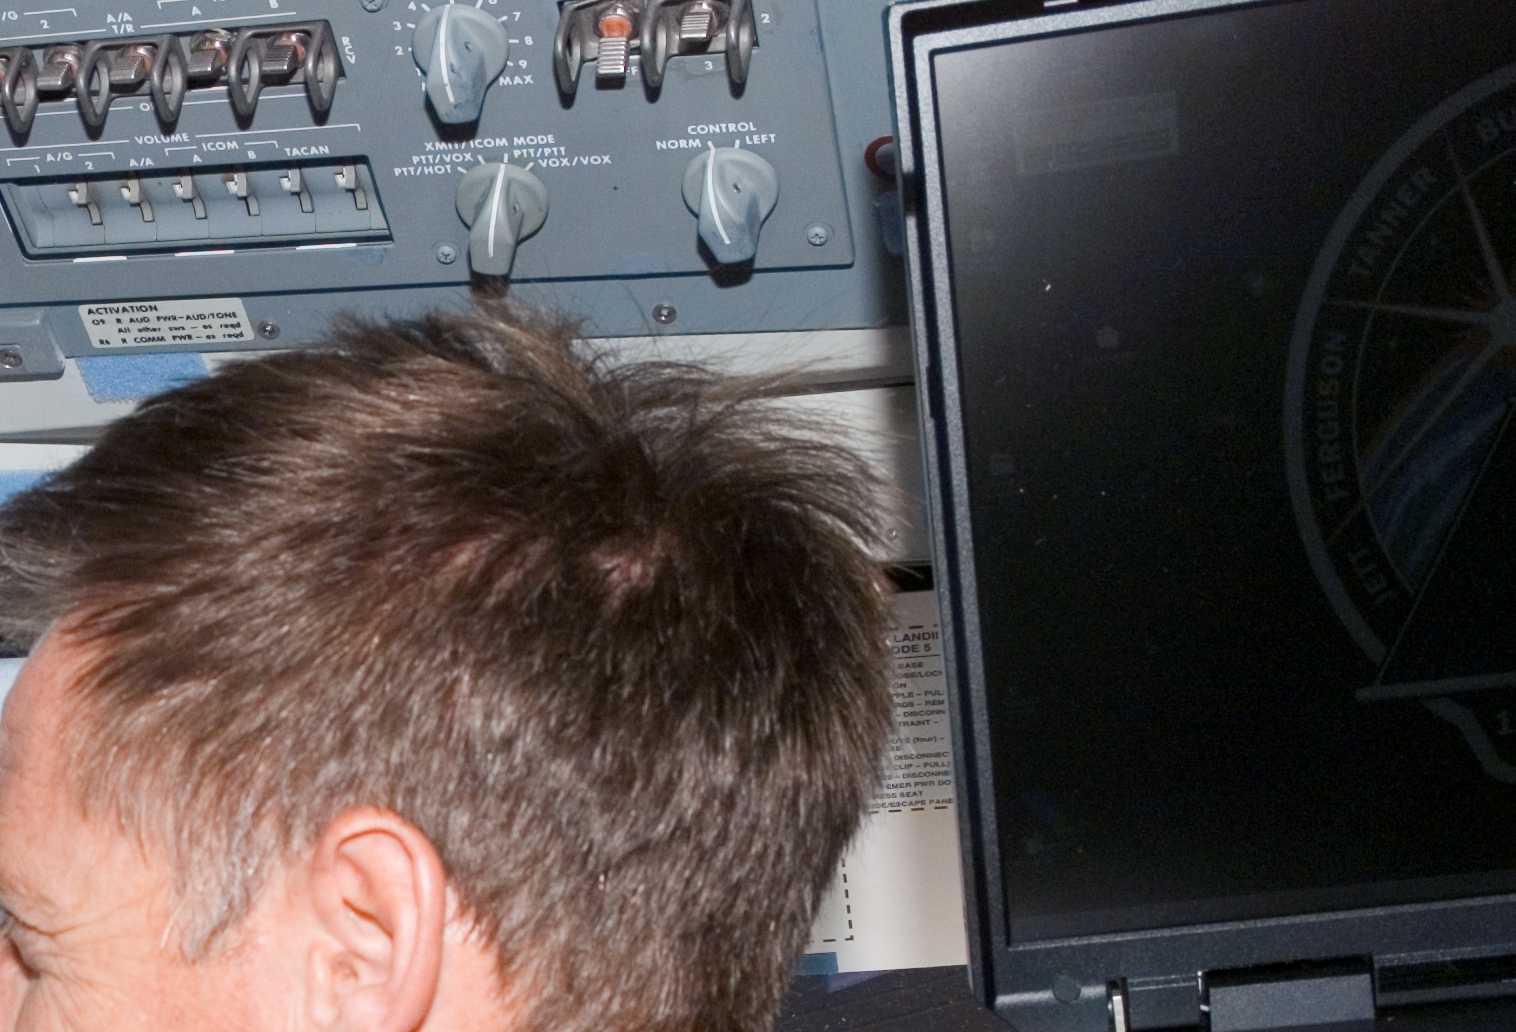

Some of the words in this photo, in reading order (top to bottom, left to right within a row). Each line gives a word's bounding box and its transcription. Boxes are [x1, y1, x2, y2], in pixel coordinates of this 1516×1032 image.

[408, 2, 417, 11] 4
[107, 12, 133, 24] A/A
[512, 12, 521, 21] 7
[761, 14, 770, 24] 2
[40, 20, 50, 29] 2
[112, 24, 134, 34] T/R
[393, 21, 402, 31] 3
[524, 36, 534, 46] 8
[341, 36, 356, 65] RCV
[394, 46, 404, 55] 2
[519, 60, 528, 69] 9
[704, 61, 713, 71] 3
[499, 74, 534, 87] MAX
[687, 121, 757, 135] CONTROL
[134, 132, 190, 145] VOLUME
[424, 136, 509, 152] XMIT/ICOM
[513, 134, 556, 147] MODE
[655, 138, 702, 150] NORM
[745, 133, 777, 145] LEFT
[202, 140, 240, 152] ICOM
[284, 145, 330, 157] TACAN
[46, 152, 73, 162] A/G
[513, 146, 566, 159] PTT/PTT
[129, 157, 155, 167] A/A
[411, 152, 474, 165] PTT/VOX
[538, 154, 612, 168] VOX/VOX
[85, 162, 94, 170] 2
[393, 164, 452, 177] PTT/HOT
[87, 304, 159, 315] ACTIVATION
[129, 316, 151, 324] AUD
[118, 326, 131, 334] All
[137, 325, 161, 334] other
[134, 335, 167, 344] COMM
[172, 333, 194, 342] PWR
[1324, 329, 1349, 502] FERGUSON
[891, 644, 920, 655] ODE
[924, 643, 932, 652] 5
